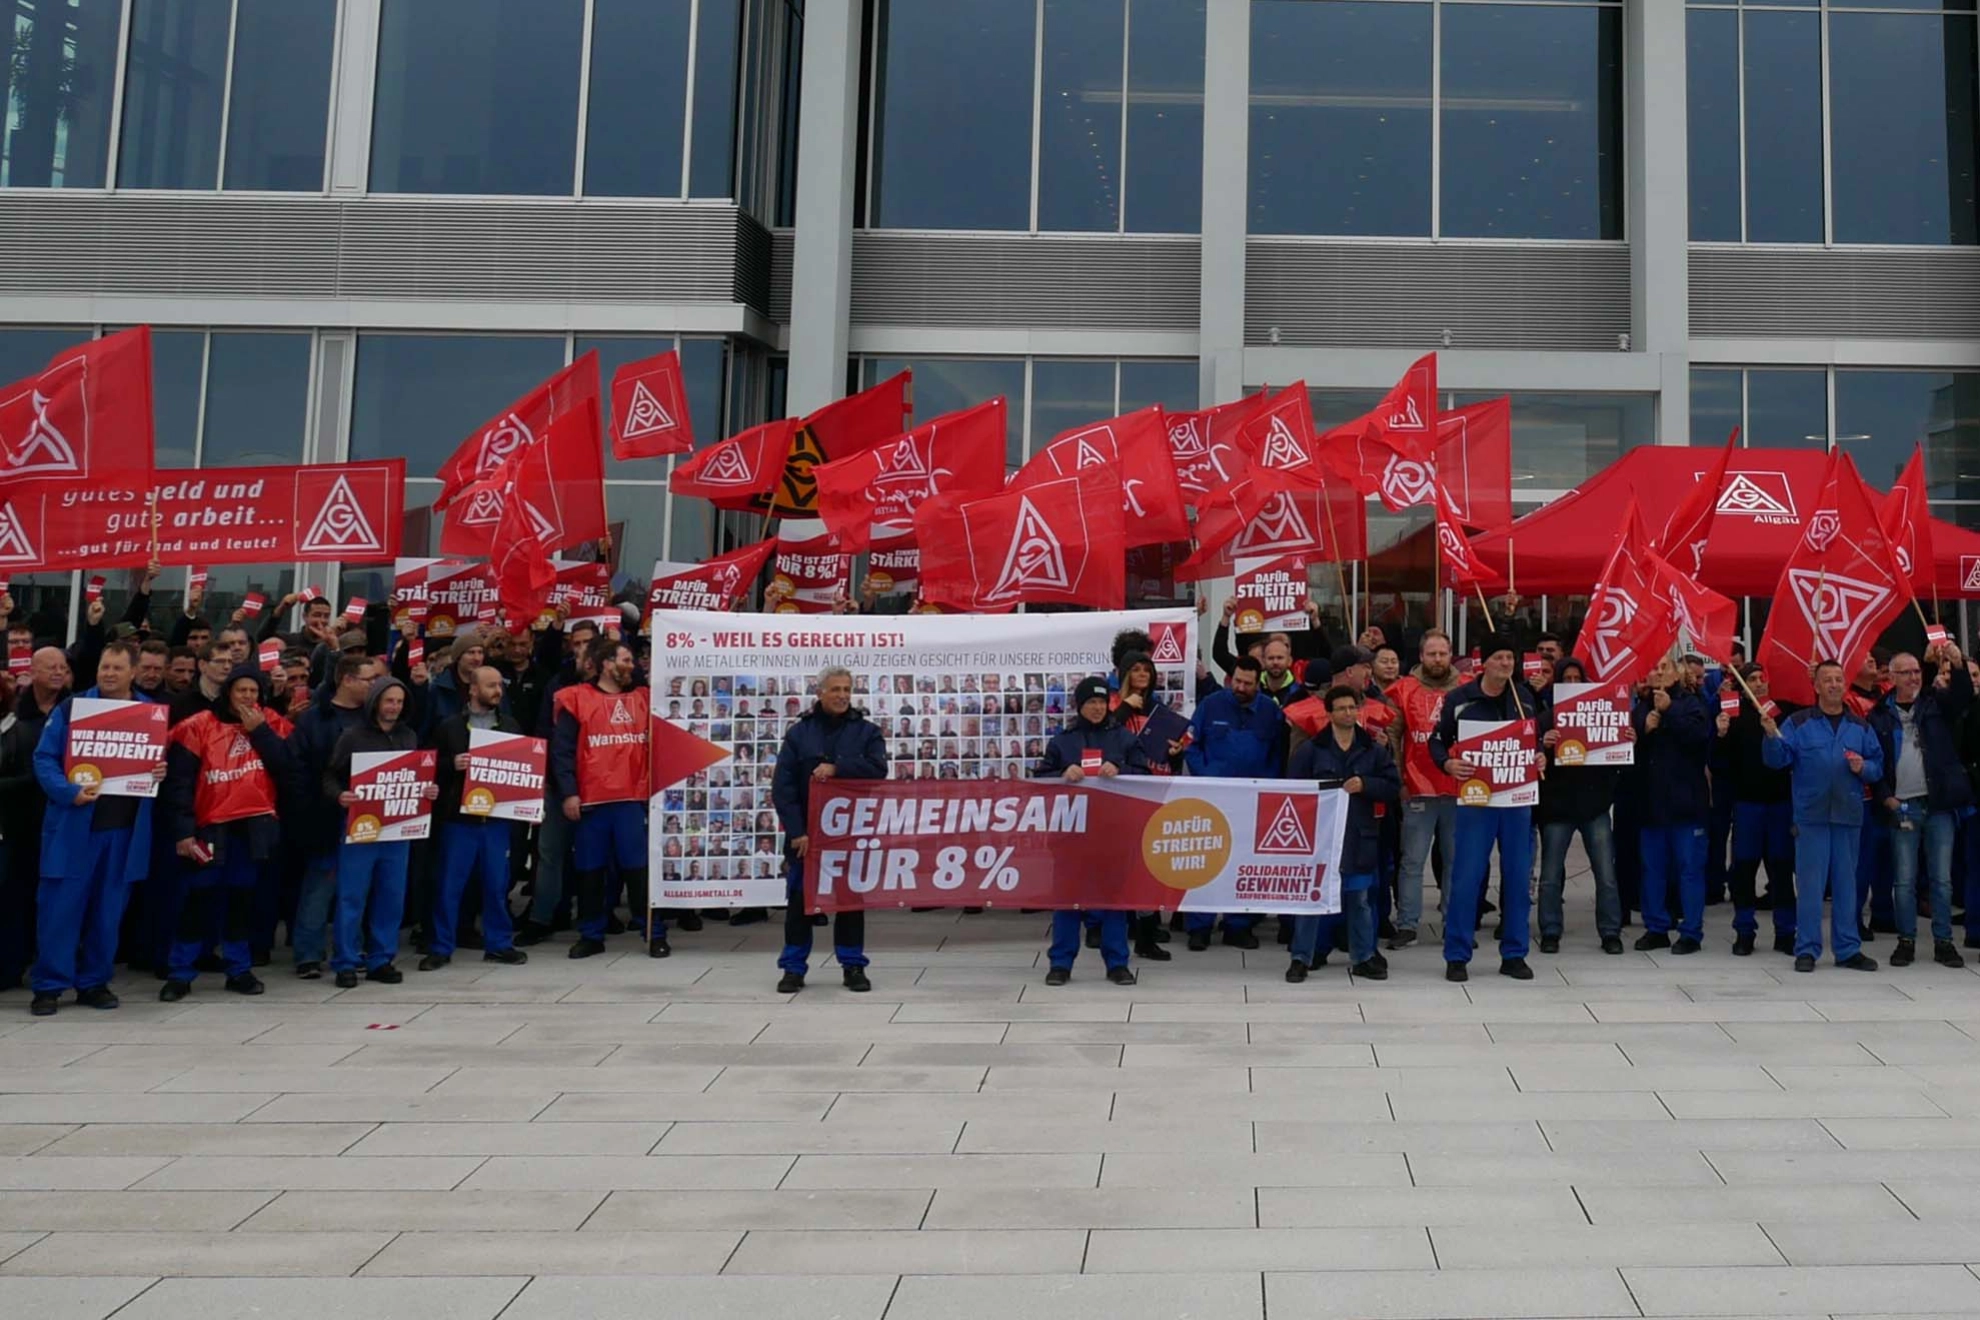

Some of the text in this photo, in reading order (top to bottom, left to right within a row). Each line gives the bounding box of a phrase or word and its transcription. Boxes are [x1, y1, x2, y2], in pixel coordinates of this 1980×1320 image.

[214, 479, 264, 499] und
[106, 510, 164, 534] gute
[1753, 514, 1800, 524] Allgäu
[113, 541, 141, 556] für
[189, 538, 220, 551] und
[226, 537, 278, 550] leute!
[776, 554, 802, 576] FÜR
[792, 554, 802, 562] ES
[804, 556, 820, 564] IST
[450, 578, 484, 590] DAFÜR
[1255, 570, 1289, 583] DAFÜR
[673, 580, 708, 592] DAFÜR
[1237, 582, 1306, 598] STREITEN
[430, 588, 499, 604] STREITEN
[650, 589, 720, 609] STREITEN
[1265, 596, 1296, 611] WIR
[458, 603, 478, 617] WI
[666, 632, 694, 648] 8%
[713, 632, 756, 648] WEIL
[762, 632, 784, 648] ES
[788, 632, 866, 648] GERECHT
[872, 632, 904, 648] IST!
[666, 655, 690, 668] WIR
[803, 654, 818, 668] IM
[872, 652, 916, 667] ZEIGEN
[920, 652, 969, 667] GESICHT
[973, 651, 996, 666] FÜR
[1000, 652, 1044, 666] UNSERE
[1048, 650, 1110, 664] FORDERUN
[1576, 698, 1612, 712] DAFÜR
[1557, 712, 1630, 727] STREITEN
[72, 730, 150, 743] WIR HABEN ES
[588, 732, 648, 748] Warnstre
[1587, 727, 1618, 742] WIR
[71, 741, 164, 760] VERDIENT!
[1482, 737, 1520, 752] DAFÜR
[470, 756, 532, 772] WIR HABEN ES
[1462, 749, 1535, 767] STREITEN
[376, 768, 416, 784] DAFÜR
[470, 767, 544, 789] VERDIENT!
[1492, 766, 1526, 784] WIR
[384, 799, 418, 816] WIR
[820, 794, 1088, 836] GEMEINSAM
[1162, 816, 1212, 836] DAFÜR
[1152, 836, 1223, 854] STREITEN
[818, 838, 919, 894] FÜR
[1171, 855, 1206, 871] WIR!
[1238, 864, 1312, 876] SOLIDARITÄT
